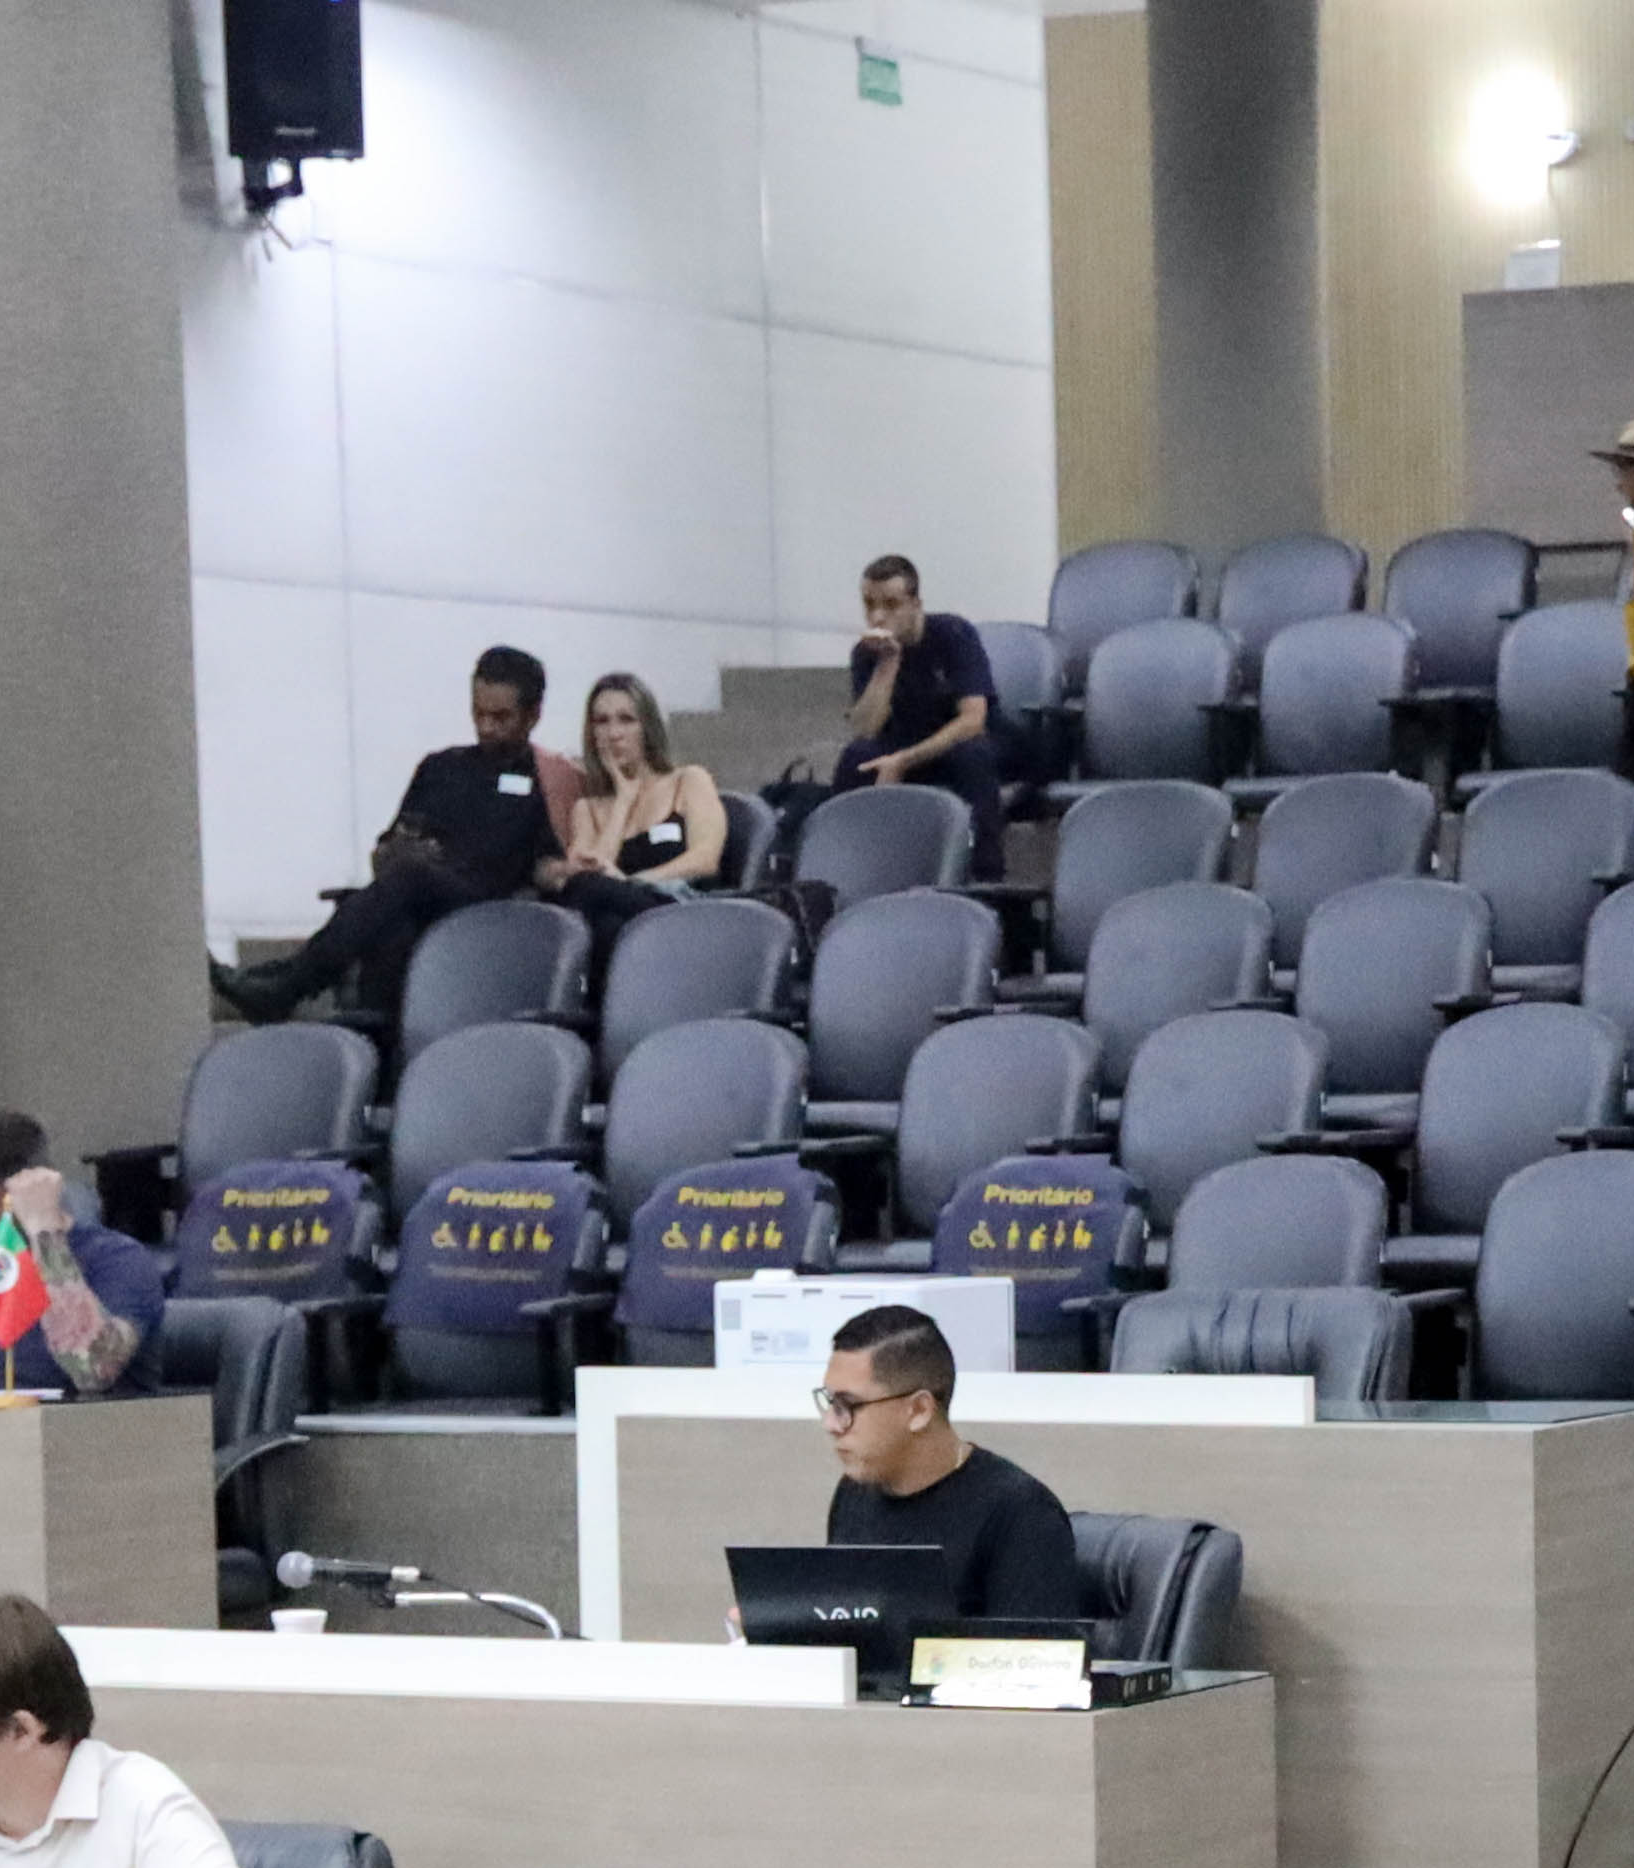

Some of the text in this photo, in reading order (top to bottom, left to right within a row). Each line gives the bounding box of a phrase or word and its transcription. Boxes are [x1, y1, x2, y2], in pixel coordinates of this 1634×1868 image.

[448, 1186, 556, 1209] Prioritário
[678, 1186, 786, 1207] Prioritário
[983, 1184, 1094, 1206] Prioritário
